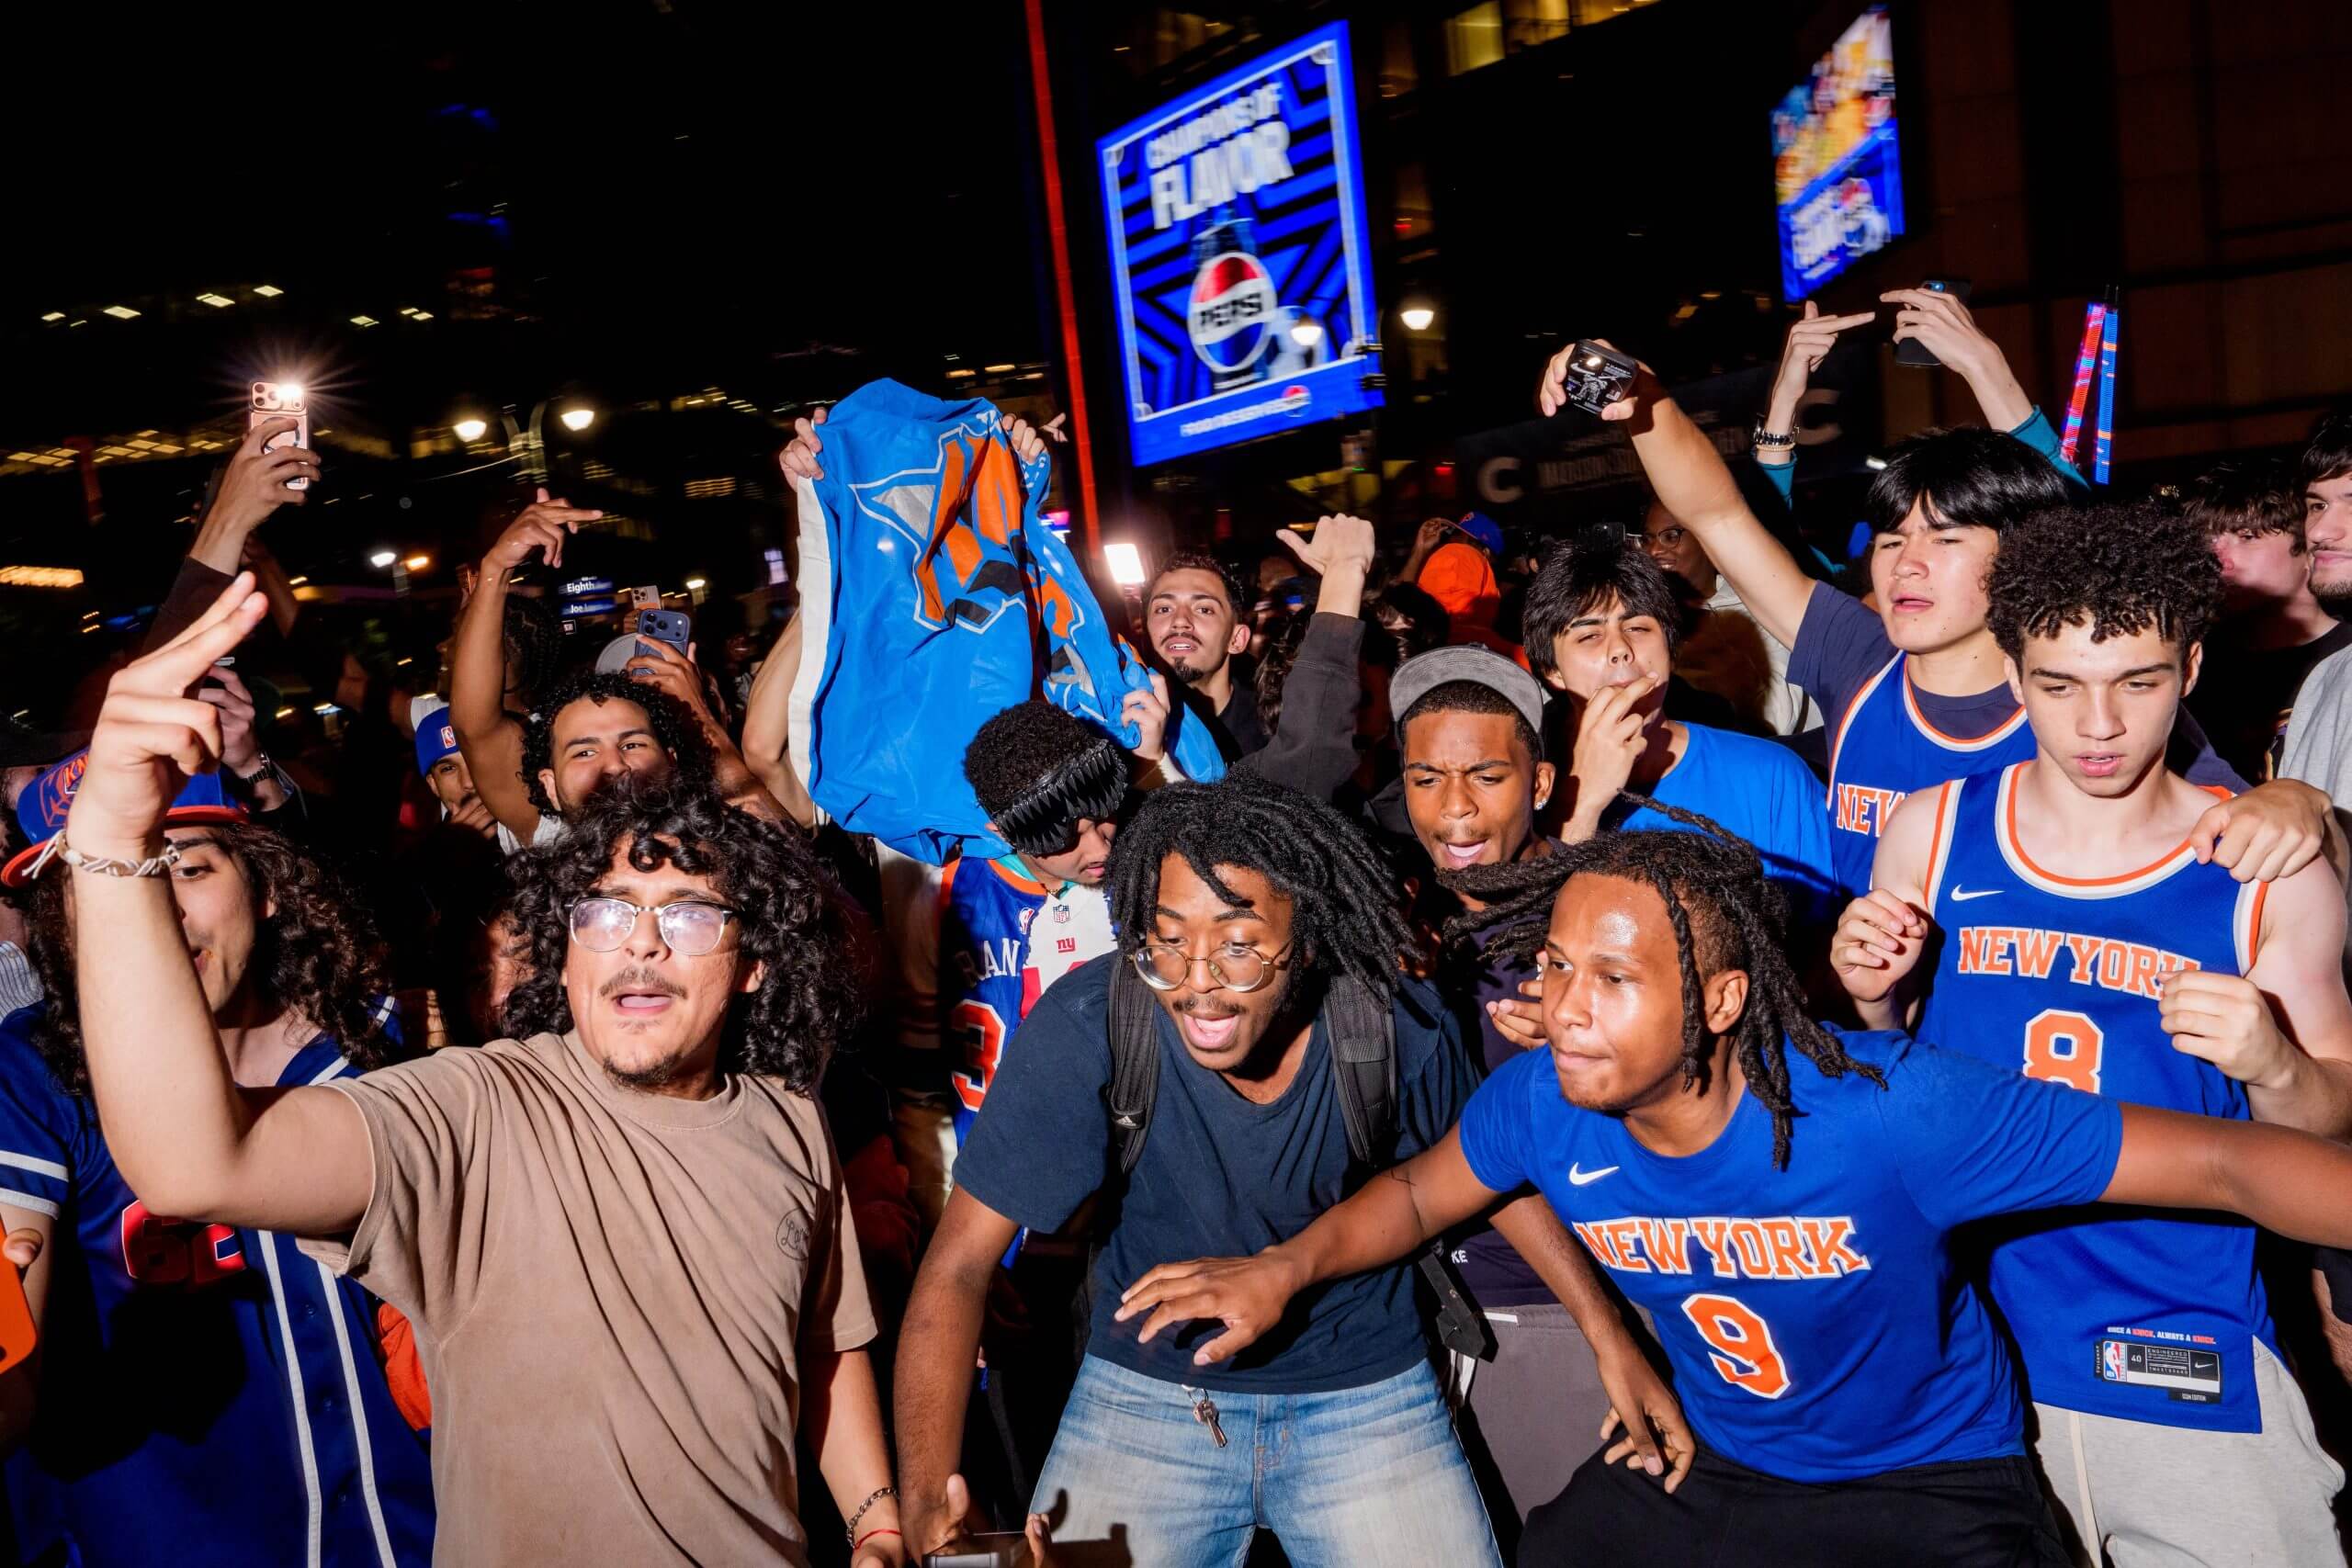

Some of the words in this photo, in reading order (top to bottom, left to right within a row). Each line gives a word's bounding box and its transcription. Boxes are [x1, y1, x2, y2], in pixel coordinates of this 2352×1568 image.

[1150, 120, 1295, 230] FLAVOR
[1200, 292, 1263, 327] PEPSI
[567, 581, 595, 594] Eighth
[1057, 937, 1076, 953] ny
[1958, 926, 2064, 979] NEW
[2023, 1009, 2104, 1095] 8
[1572, 1215, 1692, 1275] NEW
[1688, 1215, 1871, 1280] YORK
[1680, 1293, 1791, 1400] 9
[2126, 1326, 2132, 1335] A
[2156, 1331, 2185, 1341] ALWAYS
[2186, 1334, 2191, 1342] A
[2131, 1354, 2143, 1363] 40
